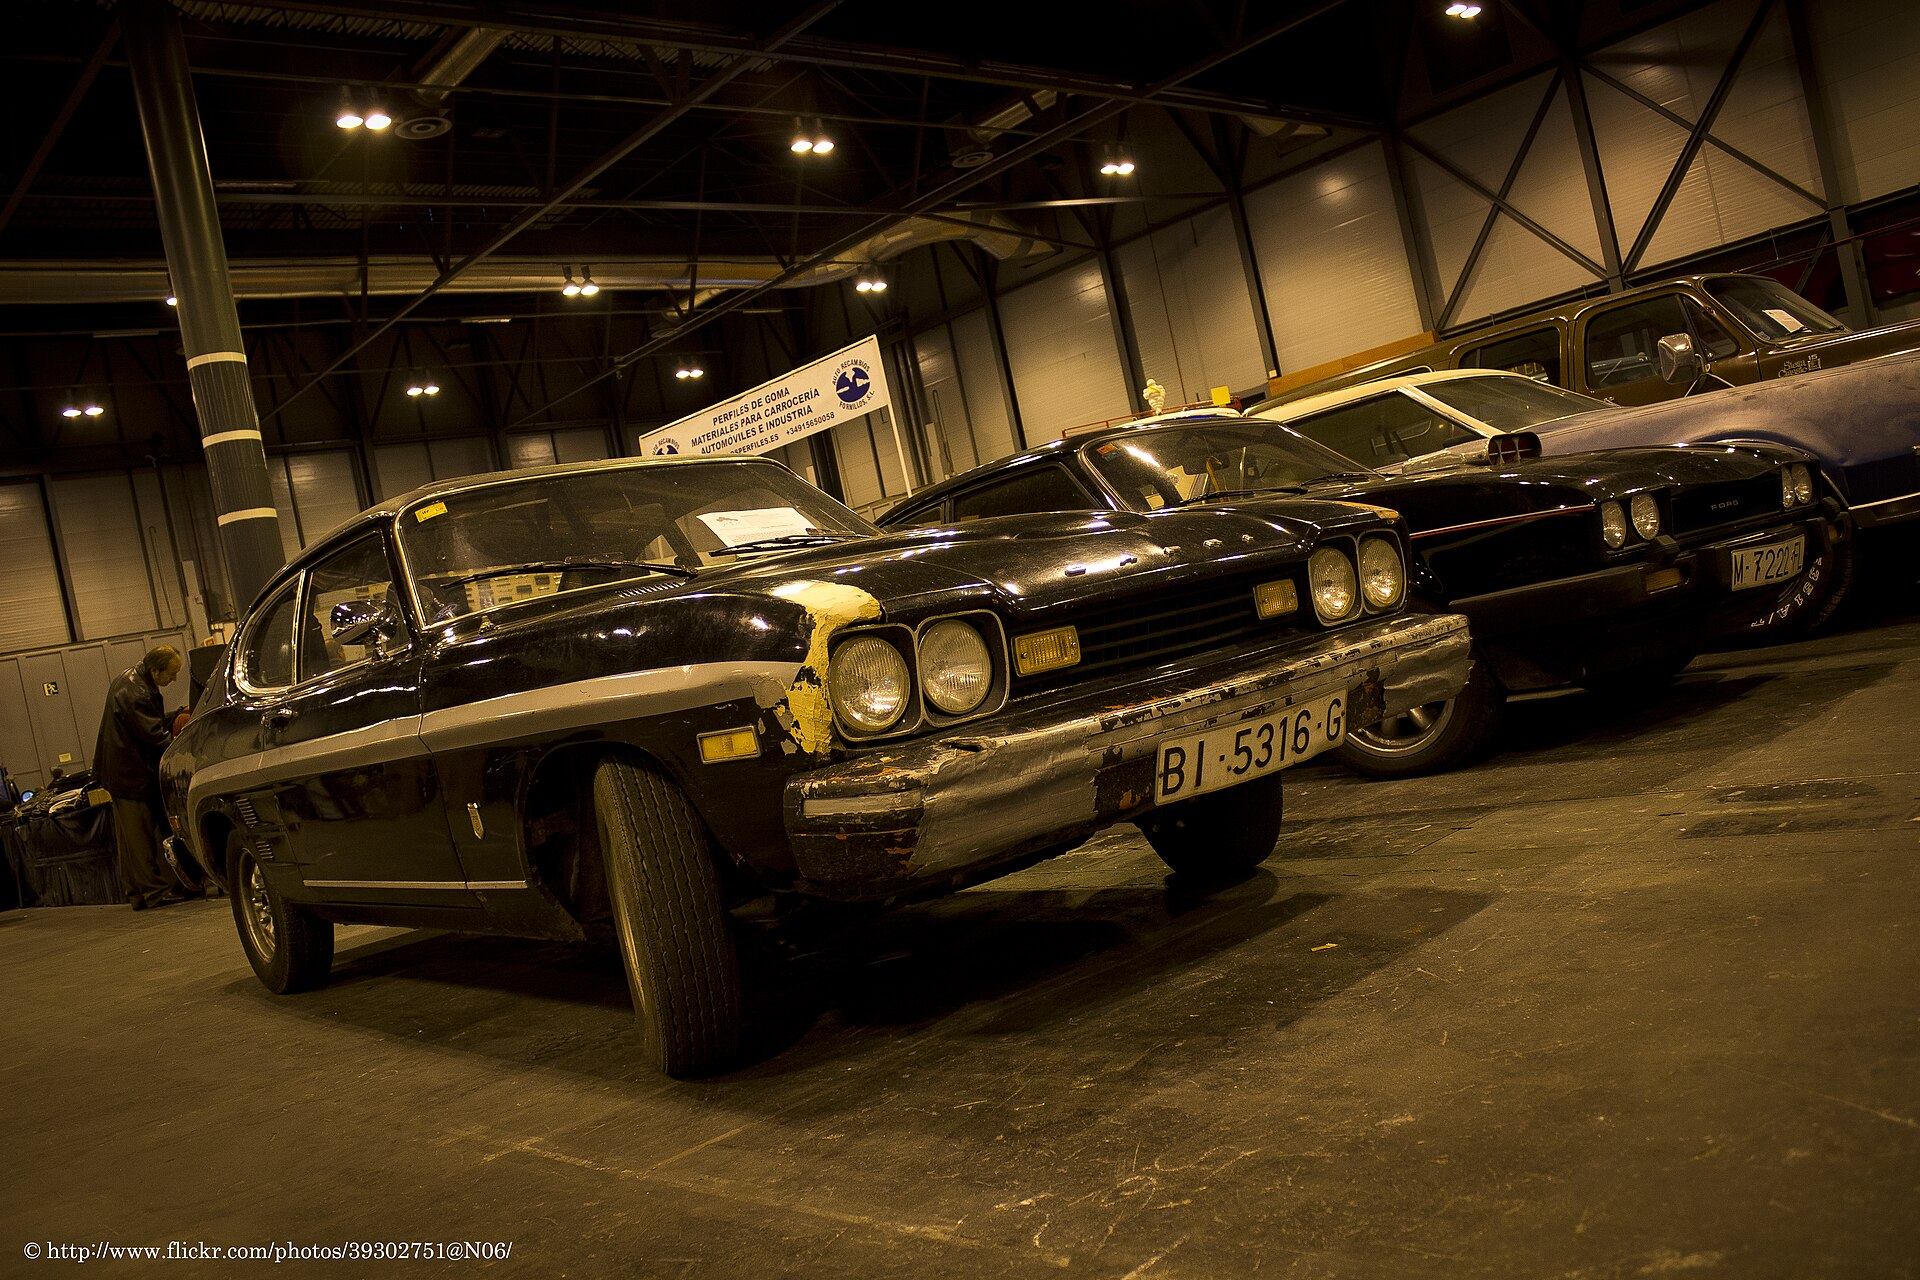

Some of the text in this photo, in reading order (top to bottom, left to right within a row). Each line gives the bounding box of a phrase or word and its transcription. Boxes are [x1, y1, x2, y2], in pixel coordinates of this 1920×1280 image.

[832, 359, 871, 386] AUTO RECAMBIOS
[691, 388, 820, 448] MATERIALES PARA CARROCERÍA
[712, 387, 790, 426] PERFILES DE GOMA
[700, 405, 813, 454] AUTOMOVILES E INDUSTRIA
[1711, 500, 1739, 510] FORD
